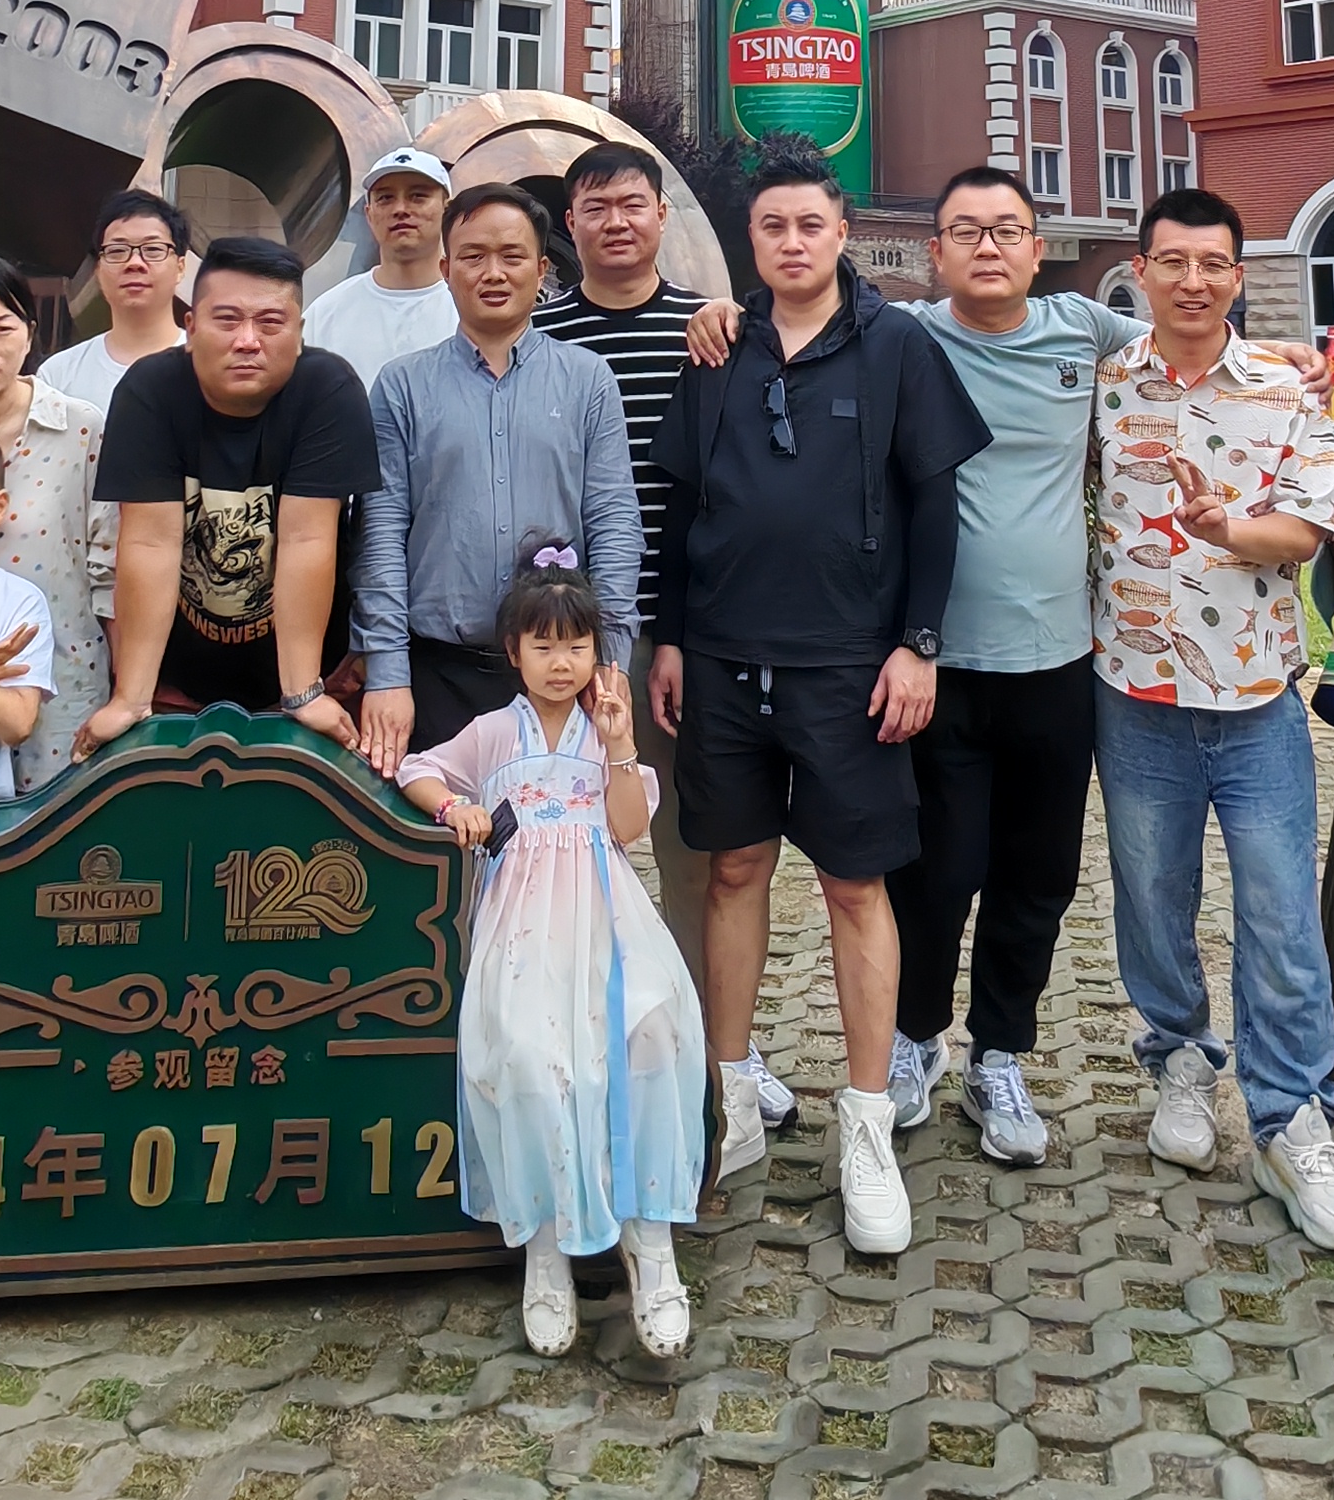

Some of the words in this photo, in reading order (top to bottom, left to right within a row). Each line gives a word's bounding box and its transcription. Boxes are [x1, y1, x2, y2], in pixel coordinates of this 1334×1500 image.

[737, 35, 856, 63] TSINGTAO
[765, 62, 831, 79] 青岛啤酒
[870, 249, 903, 268] 1903
[178, 594, 276, 644] EANSWES
[45, 888, 154, 912] TSINGTAO
[214, 845, 377, 935] 120
[56, 920, 142, 947] 青岛啤酒
[106, 1044, 287, 1091] 参观留念
